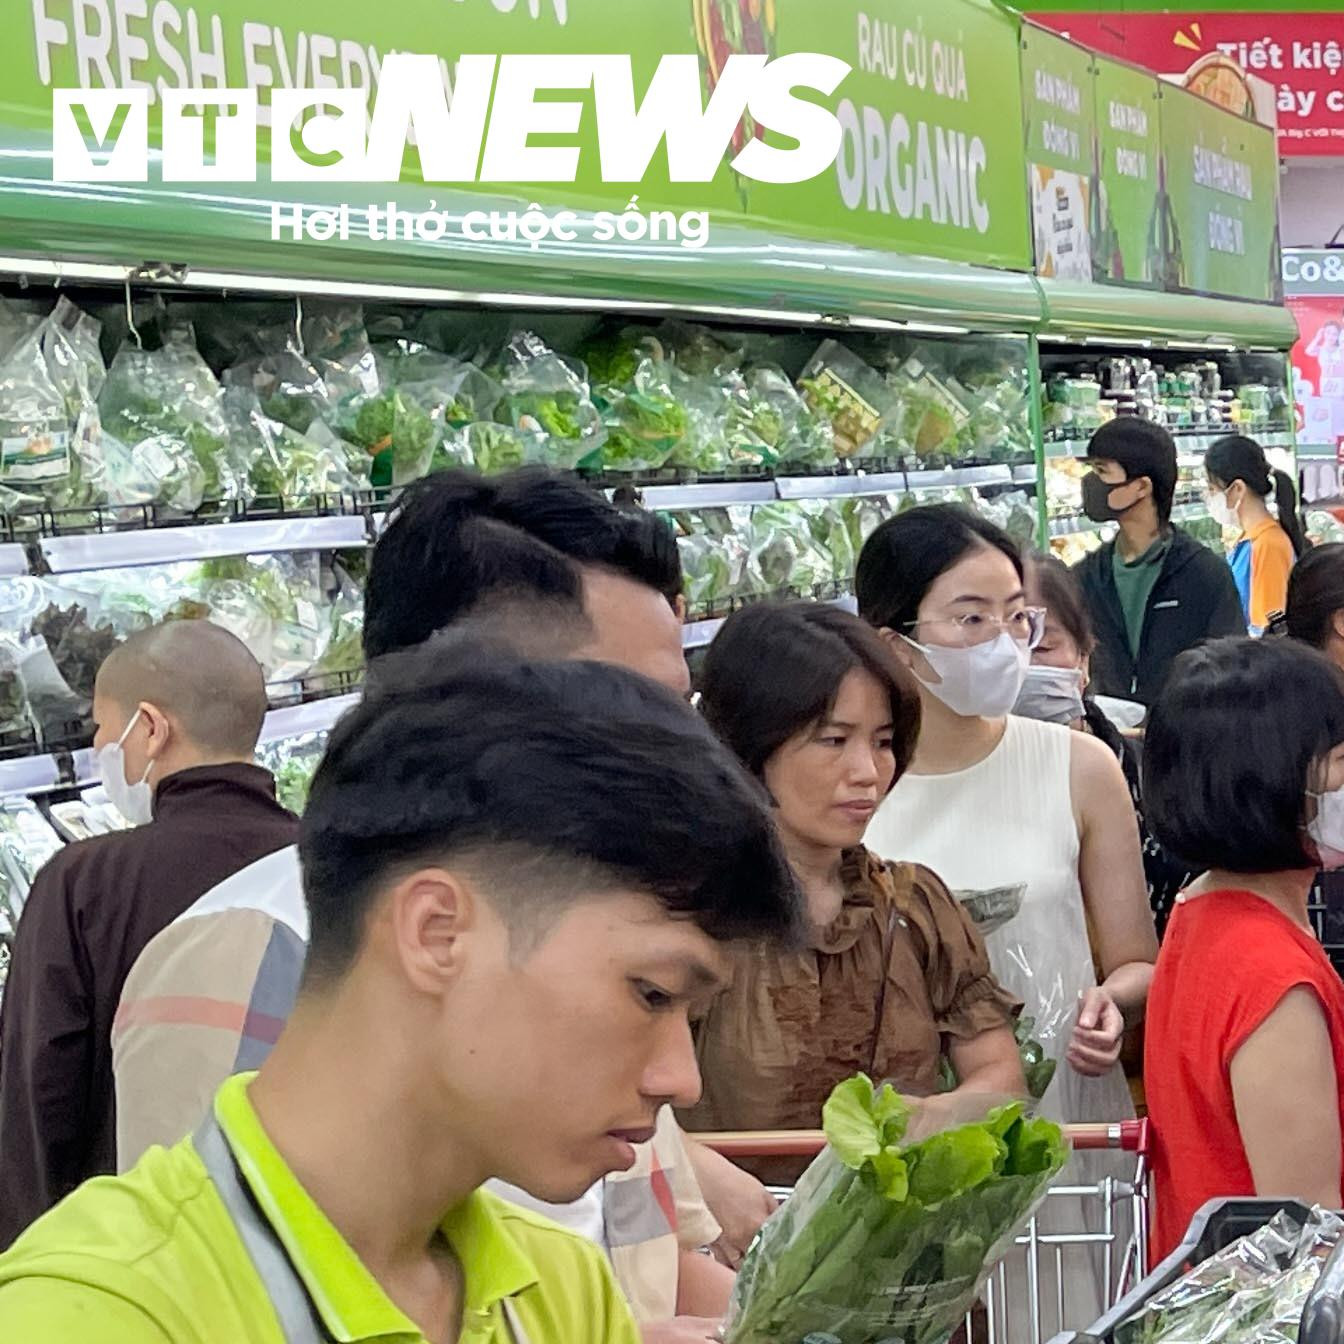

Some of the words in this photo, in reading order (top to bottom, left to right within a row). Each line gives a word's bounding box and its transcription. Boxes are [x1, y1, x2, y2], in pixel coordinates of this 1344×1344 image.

[857, 12, 898, 80] RAU
[902, 16, 928, 91] CỦ
[932, 29, 969, 102] QUẢ
[1277, 83, 1316, 117] ày
[836, 98, 990, 234] ORGANIC
